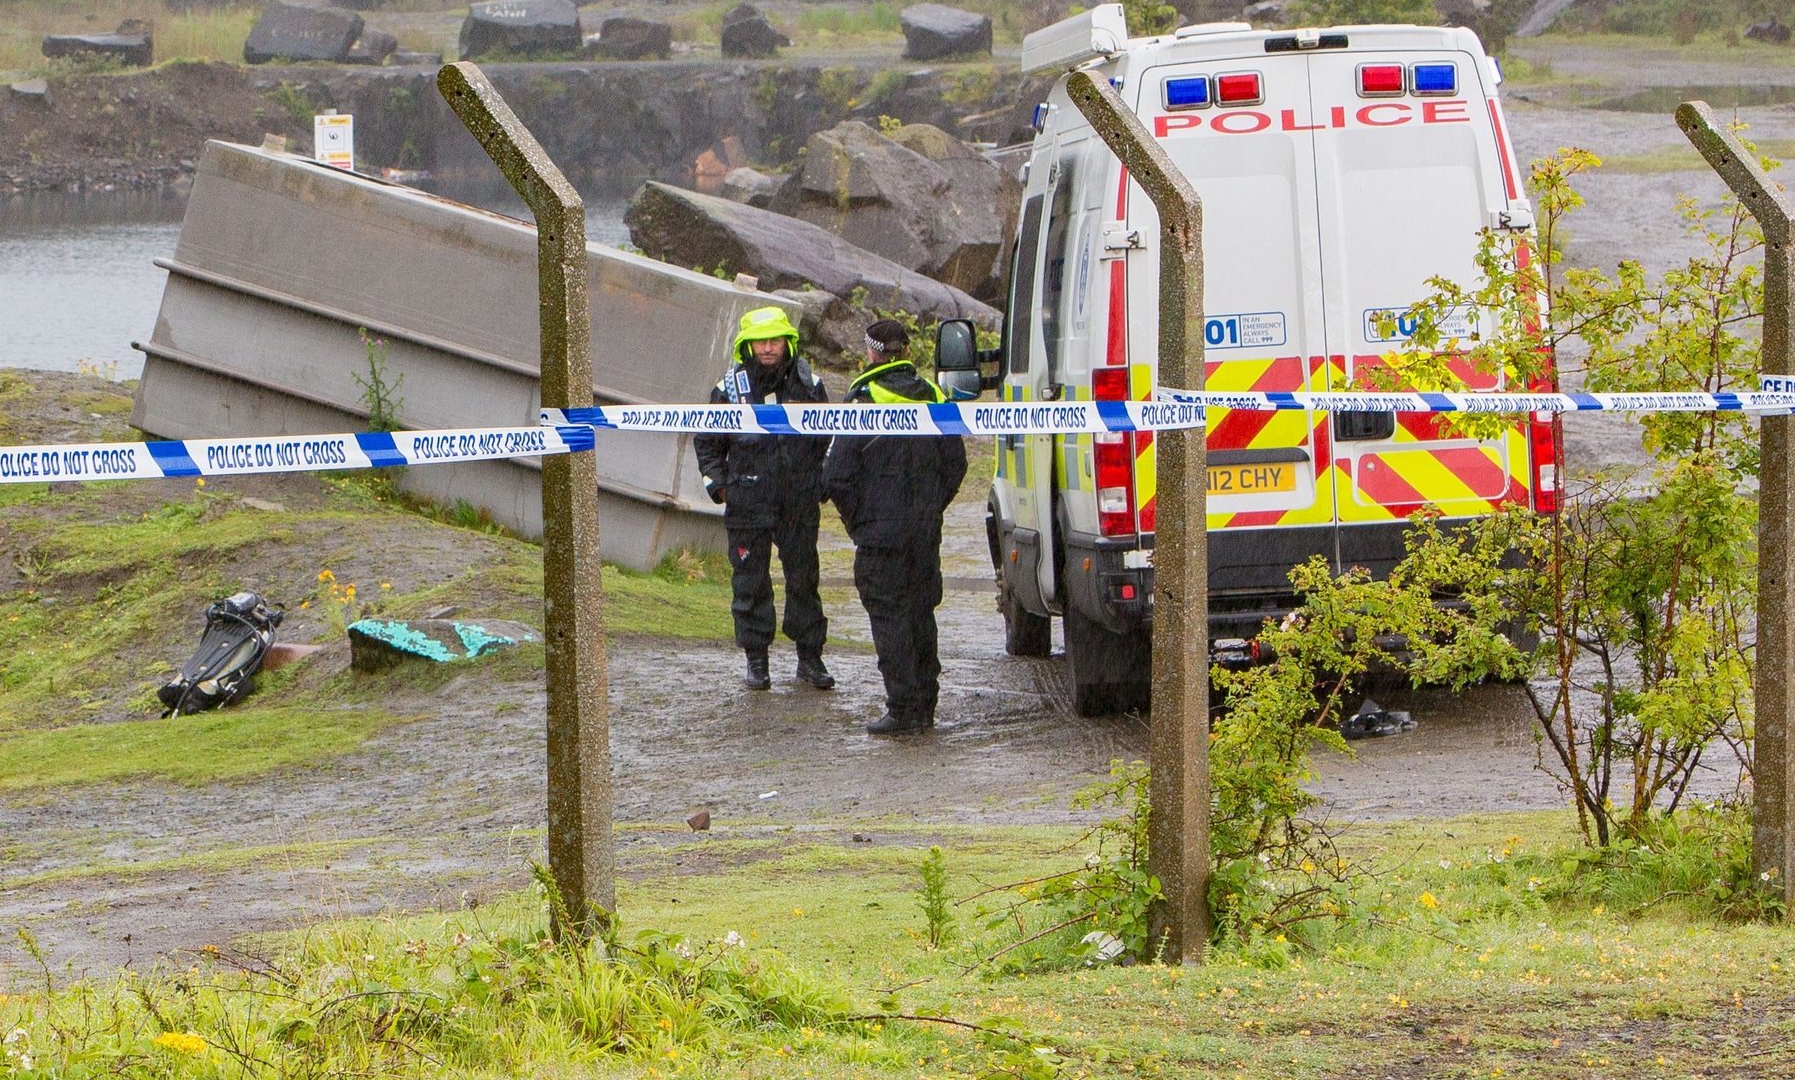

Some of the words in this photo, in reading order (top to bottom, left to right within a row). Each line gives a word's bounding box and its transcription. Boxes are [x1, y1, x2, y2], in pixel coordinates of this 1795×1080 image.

[1154, 100, 1470, 137] POLICE
[1205, 319, 1238, 345] 01
[1243, 322, 1281, 330] EMERGENCY
[1311, 398, 1347, 410] POLICE
[1347, 398, 1363, 410] DO
[1363, 398, 1383, 410] NOT
[1383, 398, 1417, 410] CROSS
[1464, 398, 1499, 411] POLICE
[1499, 398, 1514, 411] DO
[1514, 398, 1532, 410] NOT
[1533, 398, 1564, 410] CROSS
[1611, 397, 1644, 409] POLICE
[1644, 397, 1658, 409] DO
[1658, 397, 1676, 408] NOT
[1676, 396, 1707, 407] CROSS
[622, 411, 661, 426] POLICE
[662, 411, 681, 426] DO
[681, 410, 704, 428] NOT
[704, 410, 743, 430] CROSS
[802, 409, 840, 430] POLICE
[841, 409, 857, 430] DO
[860, 409, 881, 430] NOT
[883, 409, 918, 430] CROSS
[975, 408, 1012, 428] POLICE
[1014, 408, 1028, 428] DO
[1031, 408, 1051, 428] NOT
[1053, 407, 1087, 427] CROSS
[1142, 406, 1177, 425] POLICE
[1178, 405, 1192, 422] DO
[1194, 405, 1206, 421] NO
[207, 444, 253, 469] POLICE
[255, 444, 273, 467] DO
[276, 442, 300, 466] NOT
[303, 440, 346, 464] CROSS
[413, 436, 456, 459] POLICE
[458, 435, 477, 456] DO
[478, 433, 503, 454] NOT
[505, 431, 546, 452] CROSS
[43, 452, 61, 476] DO
[64, 451, 90, 475] NOT
[92, 449, 136, 474] CROSS
[1239, 468, 1281, 488] CHY
